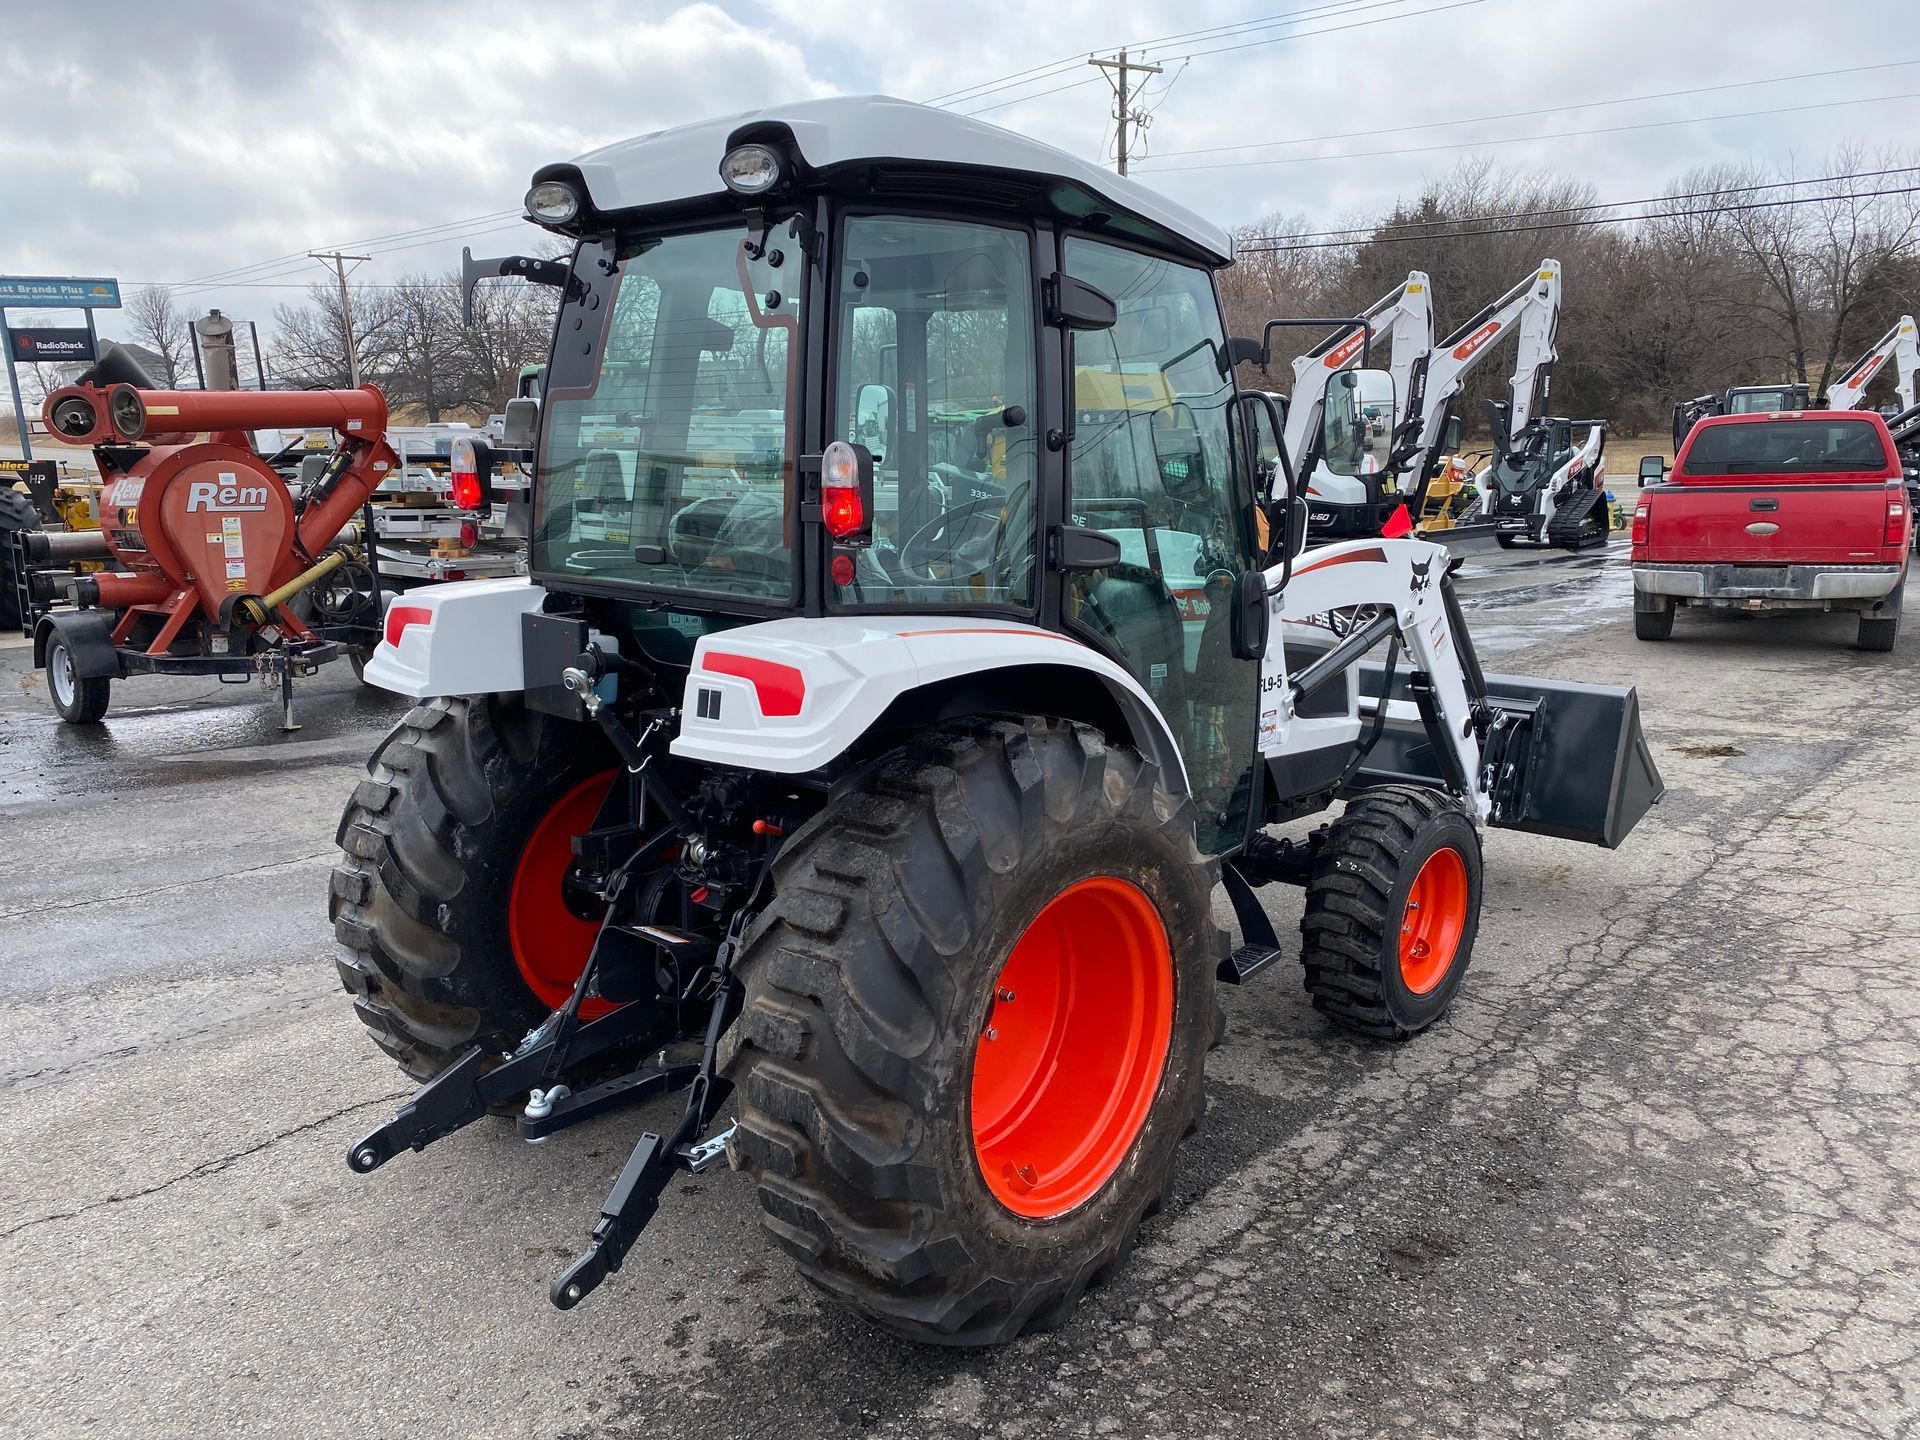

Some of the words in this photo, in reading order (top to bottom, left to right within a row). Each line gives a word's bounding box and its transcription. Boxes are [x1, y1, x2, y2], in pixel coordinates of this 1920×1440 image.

[17, 285, 57, 294] Brands
[60, 286, 84, 294] Plus
[29, 474, 46, 484] HP
[186, 482, 269, 513] Rem
